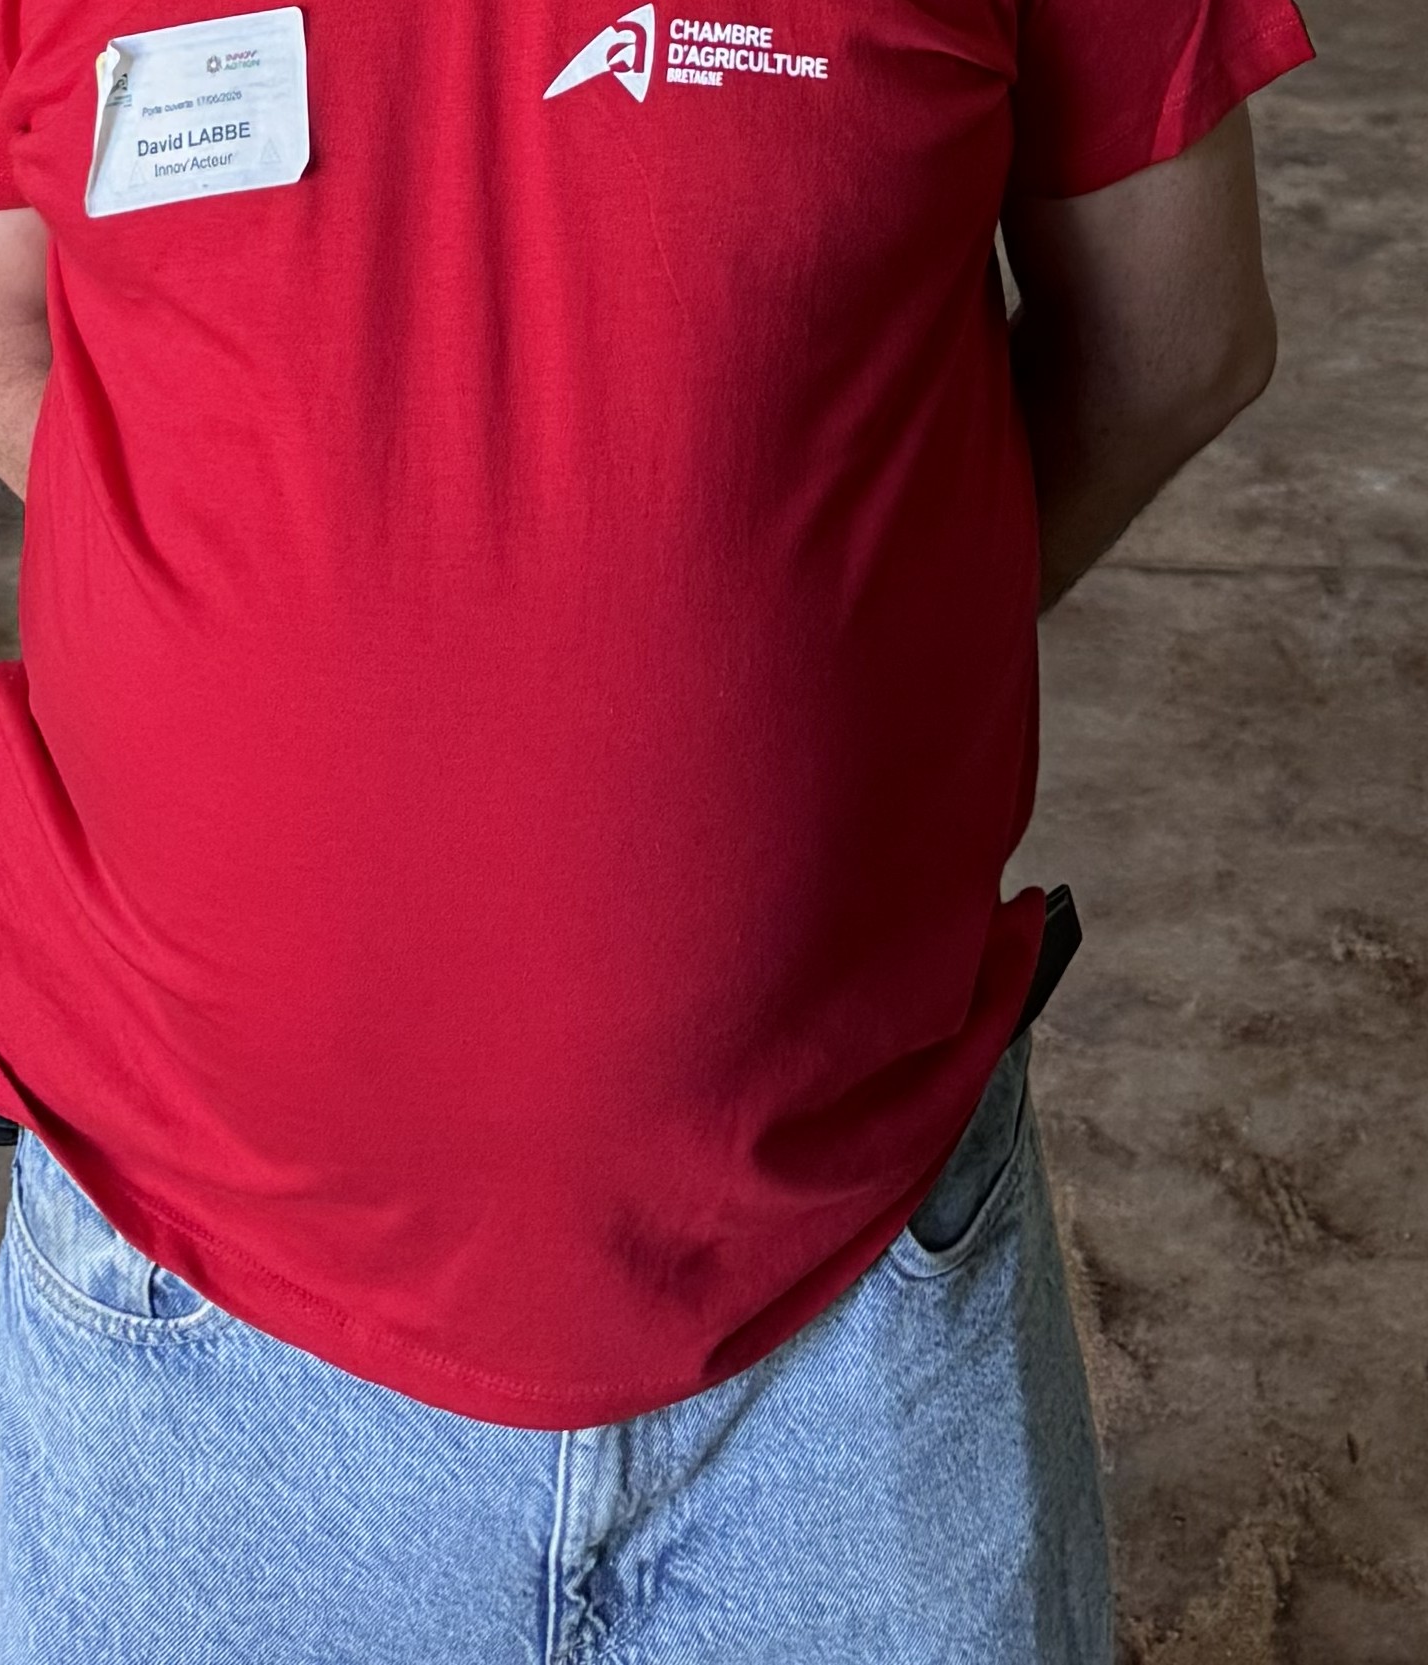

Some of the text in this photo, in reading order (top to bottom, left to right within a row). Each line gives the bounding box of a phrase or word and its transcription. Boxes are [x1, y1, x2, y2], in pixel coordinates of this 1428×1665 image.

[669, 18, 774, 48] CHAMBRE
[666, 68, 724, 87] BRETAGNE
[667, 43, 829, 80] D'AGRICULTURE
[137, 121, 251, 157] David LABBE
